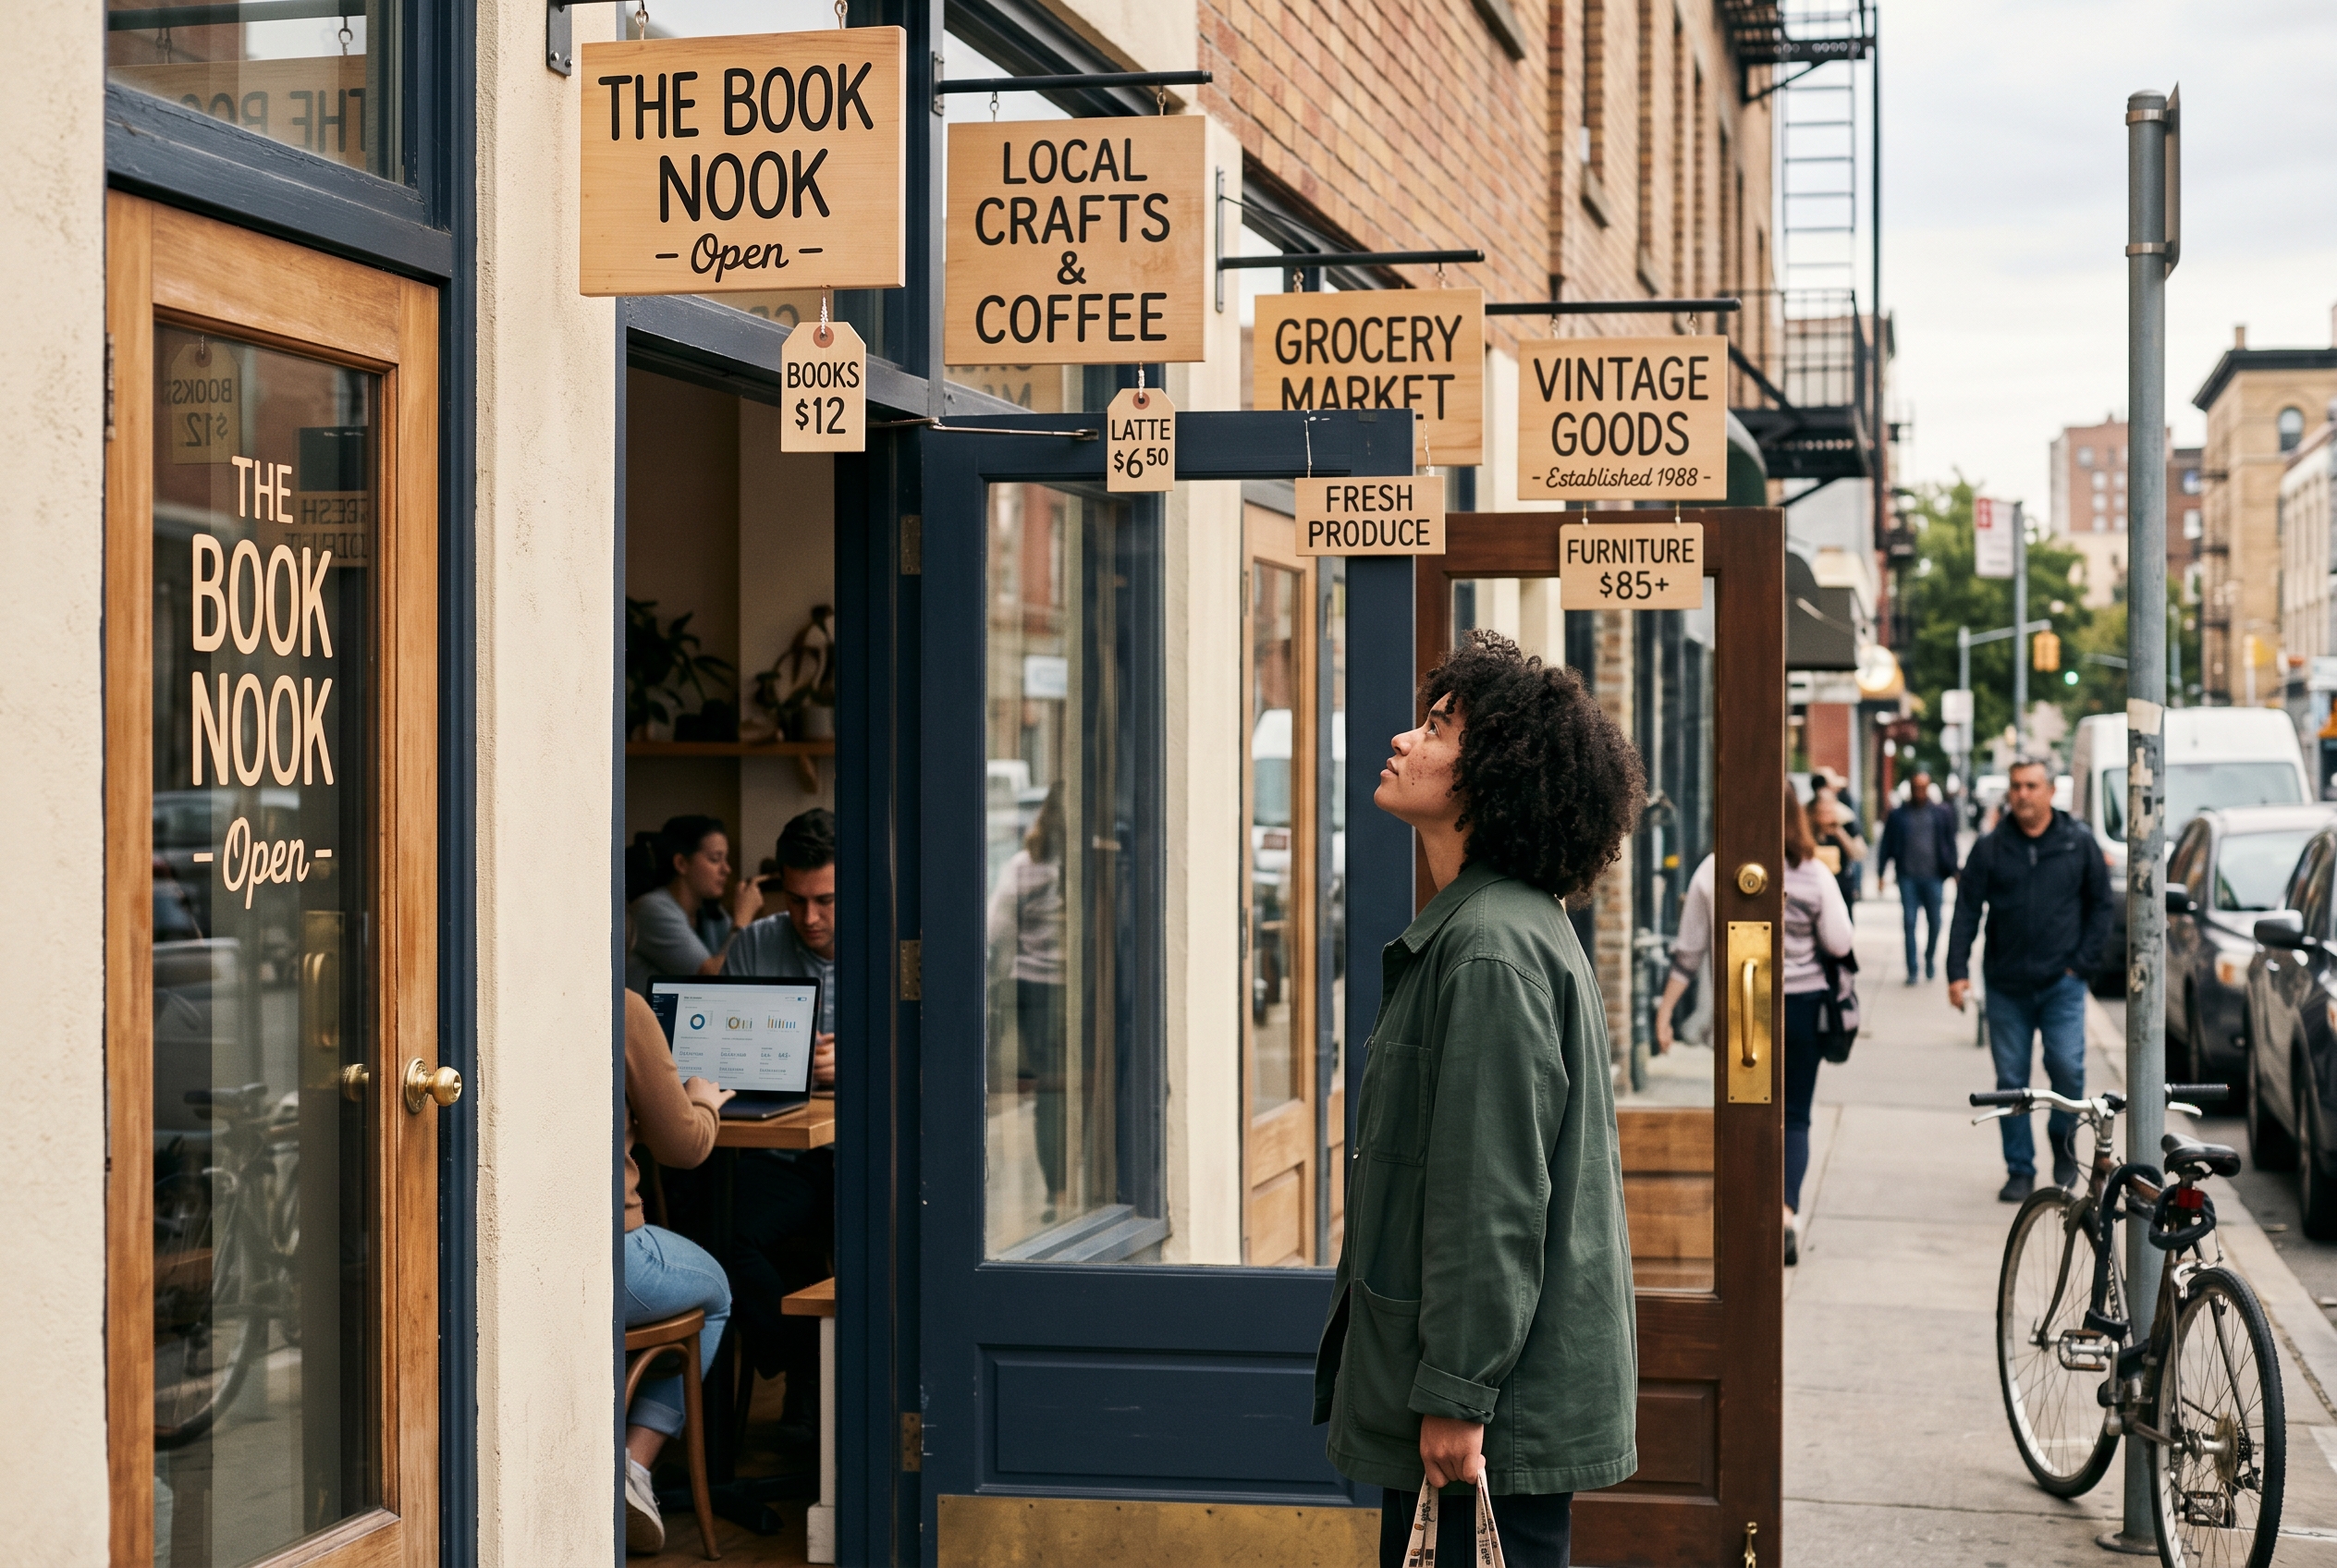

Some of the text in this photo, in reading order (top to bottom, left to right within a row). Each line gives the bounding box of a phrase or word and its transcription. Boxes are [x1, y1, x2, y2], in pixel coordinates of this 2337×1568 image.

[598, 62, 874, 141] THE BOOK
[1004, 139, 1147, 184] LOCAL
[660, 149, 829, 223] NOOK
[975, 193, 1169, 245] CRAFTS
[691, 233, 789, 283] Open
[1058, 251, 1086, 285] &
[976, 293, 1167, 344] COFFEE
[1276, 315, 1462, 364] GROCERY
[788, 361, 859, 388] BOOKS
[1534, 356, 1708, 401] VINTAGE
[796, 397, 846, 434] $12
[1281, 374, 1455, 421] MARKET
[1112, 419, 1170, 440] LATTE
[1552, 411, 1689, 456] GOODS
[232, 456, 293, 523] THE
[1327, 484, 1412, 512] FRESH
[1547, 467, 1697, 488] Established 1988
[1309, 520, 1430, 547] PRODUCE
[1568, 539, 1694, 564] FURNITURE
[193, 534, 332, 657] BOOK
[1600, 571, 1669, 599] $85+
[193, 672, 333, 786] NOOK
[224, 817, 310, 909] Open
